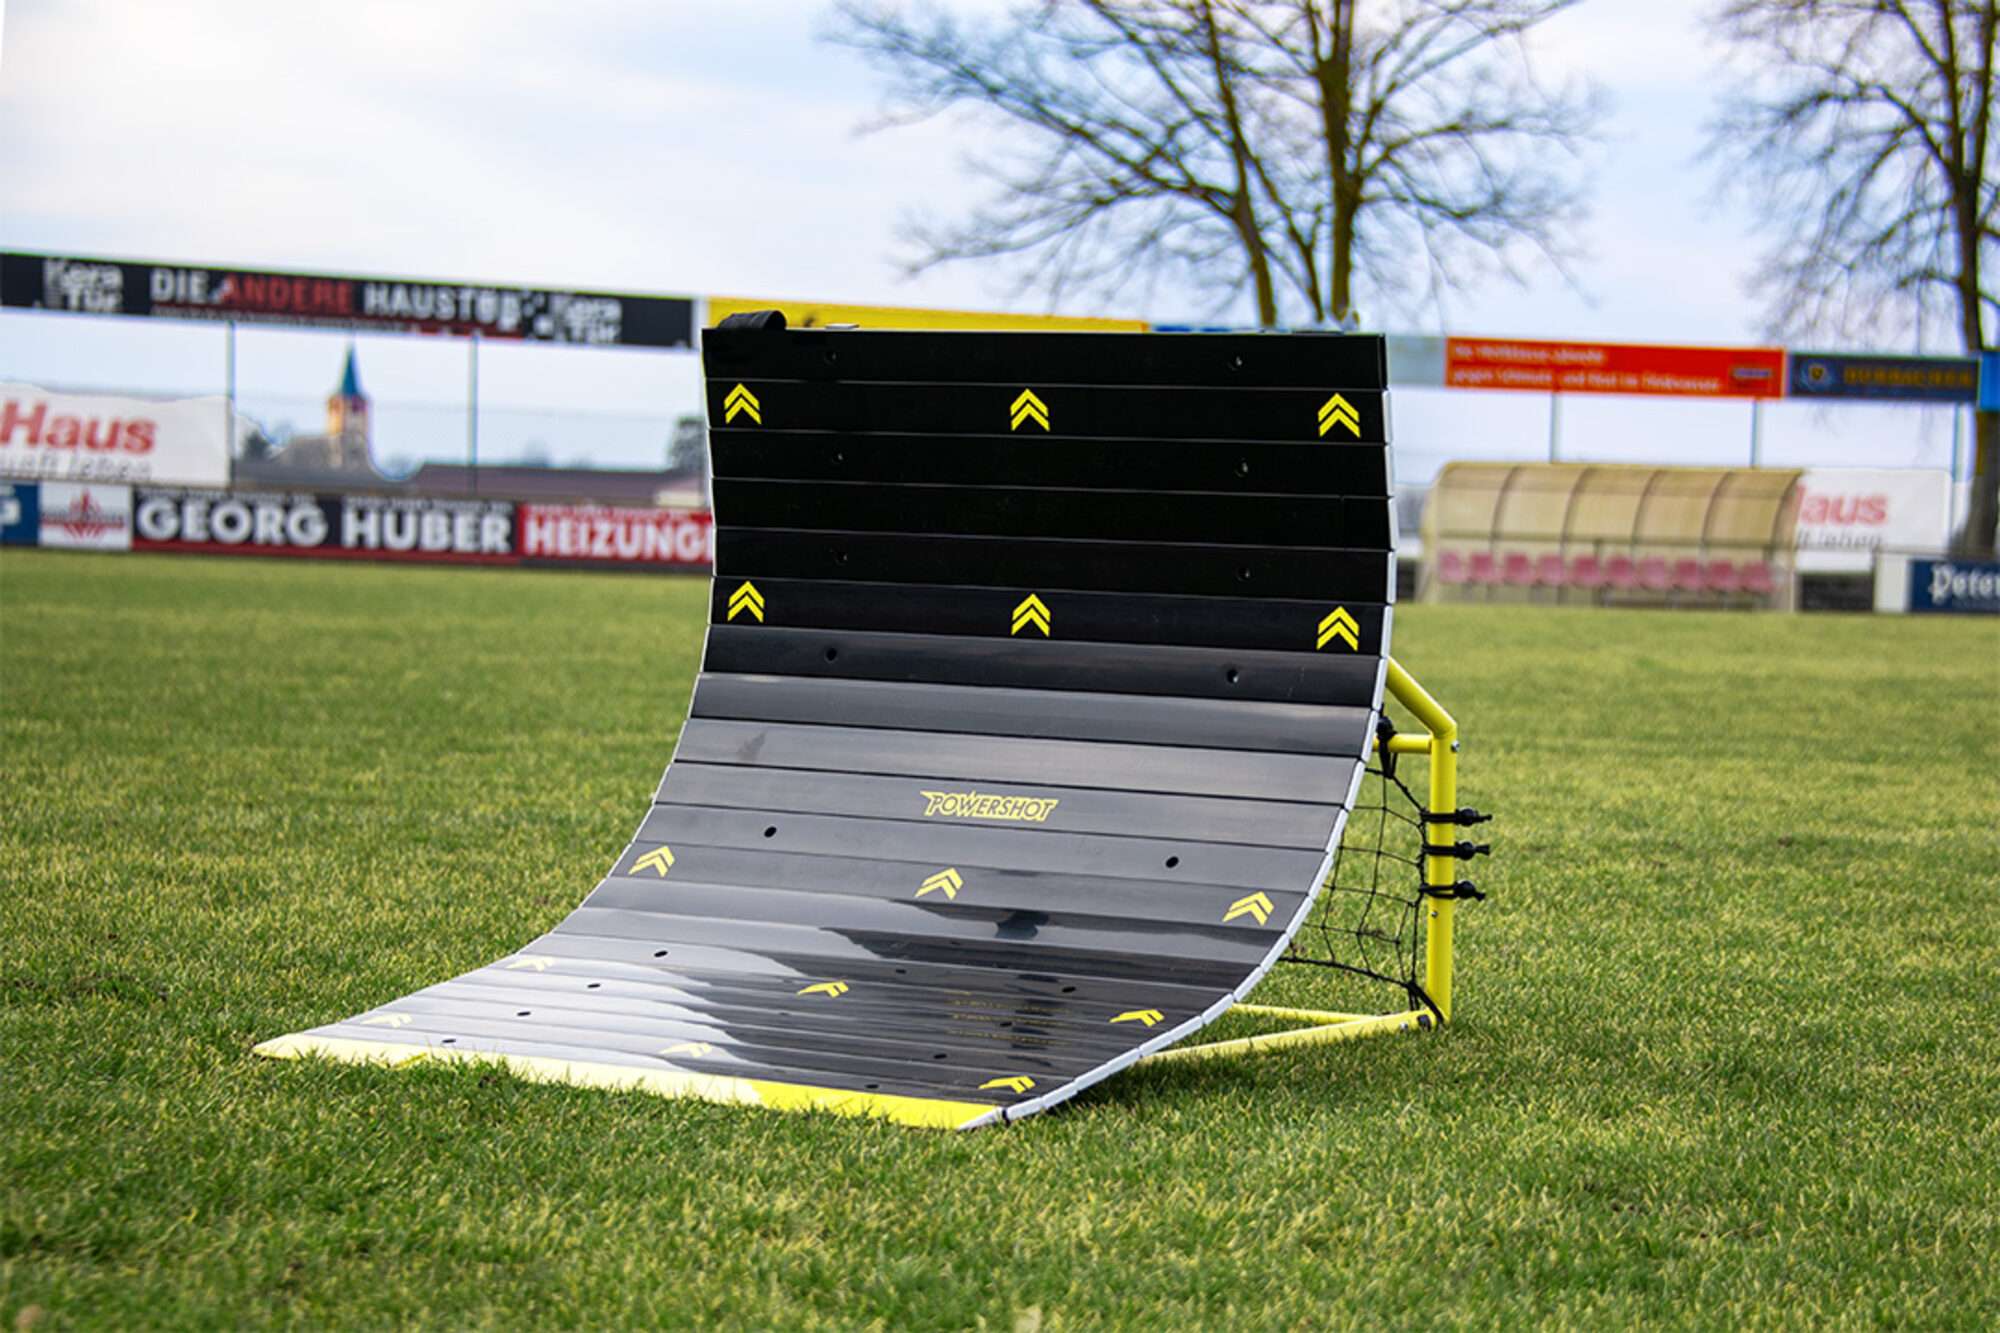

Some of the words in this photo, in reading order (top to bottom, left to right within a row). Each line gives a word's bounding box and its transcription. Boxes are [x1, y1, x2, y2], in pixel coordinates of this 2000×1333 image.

[151, 267, 208, 304] DIE
[219, 273, 353, 317] ANDERE
[0, 401, 156, 454] Haus
[136, 498, 329, 547] GEORG
[343, 507, 512, 554] HUBER
[920, 790, 1058, 822] POWERSHOT
